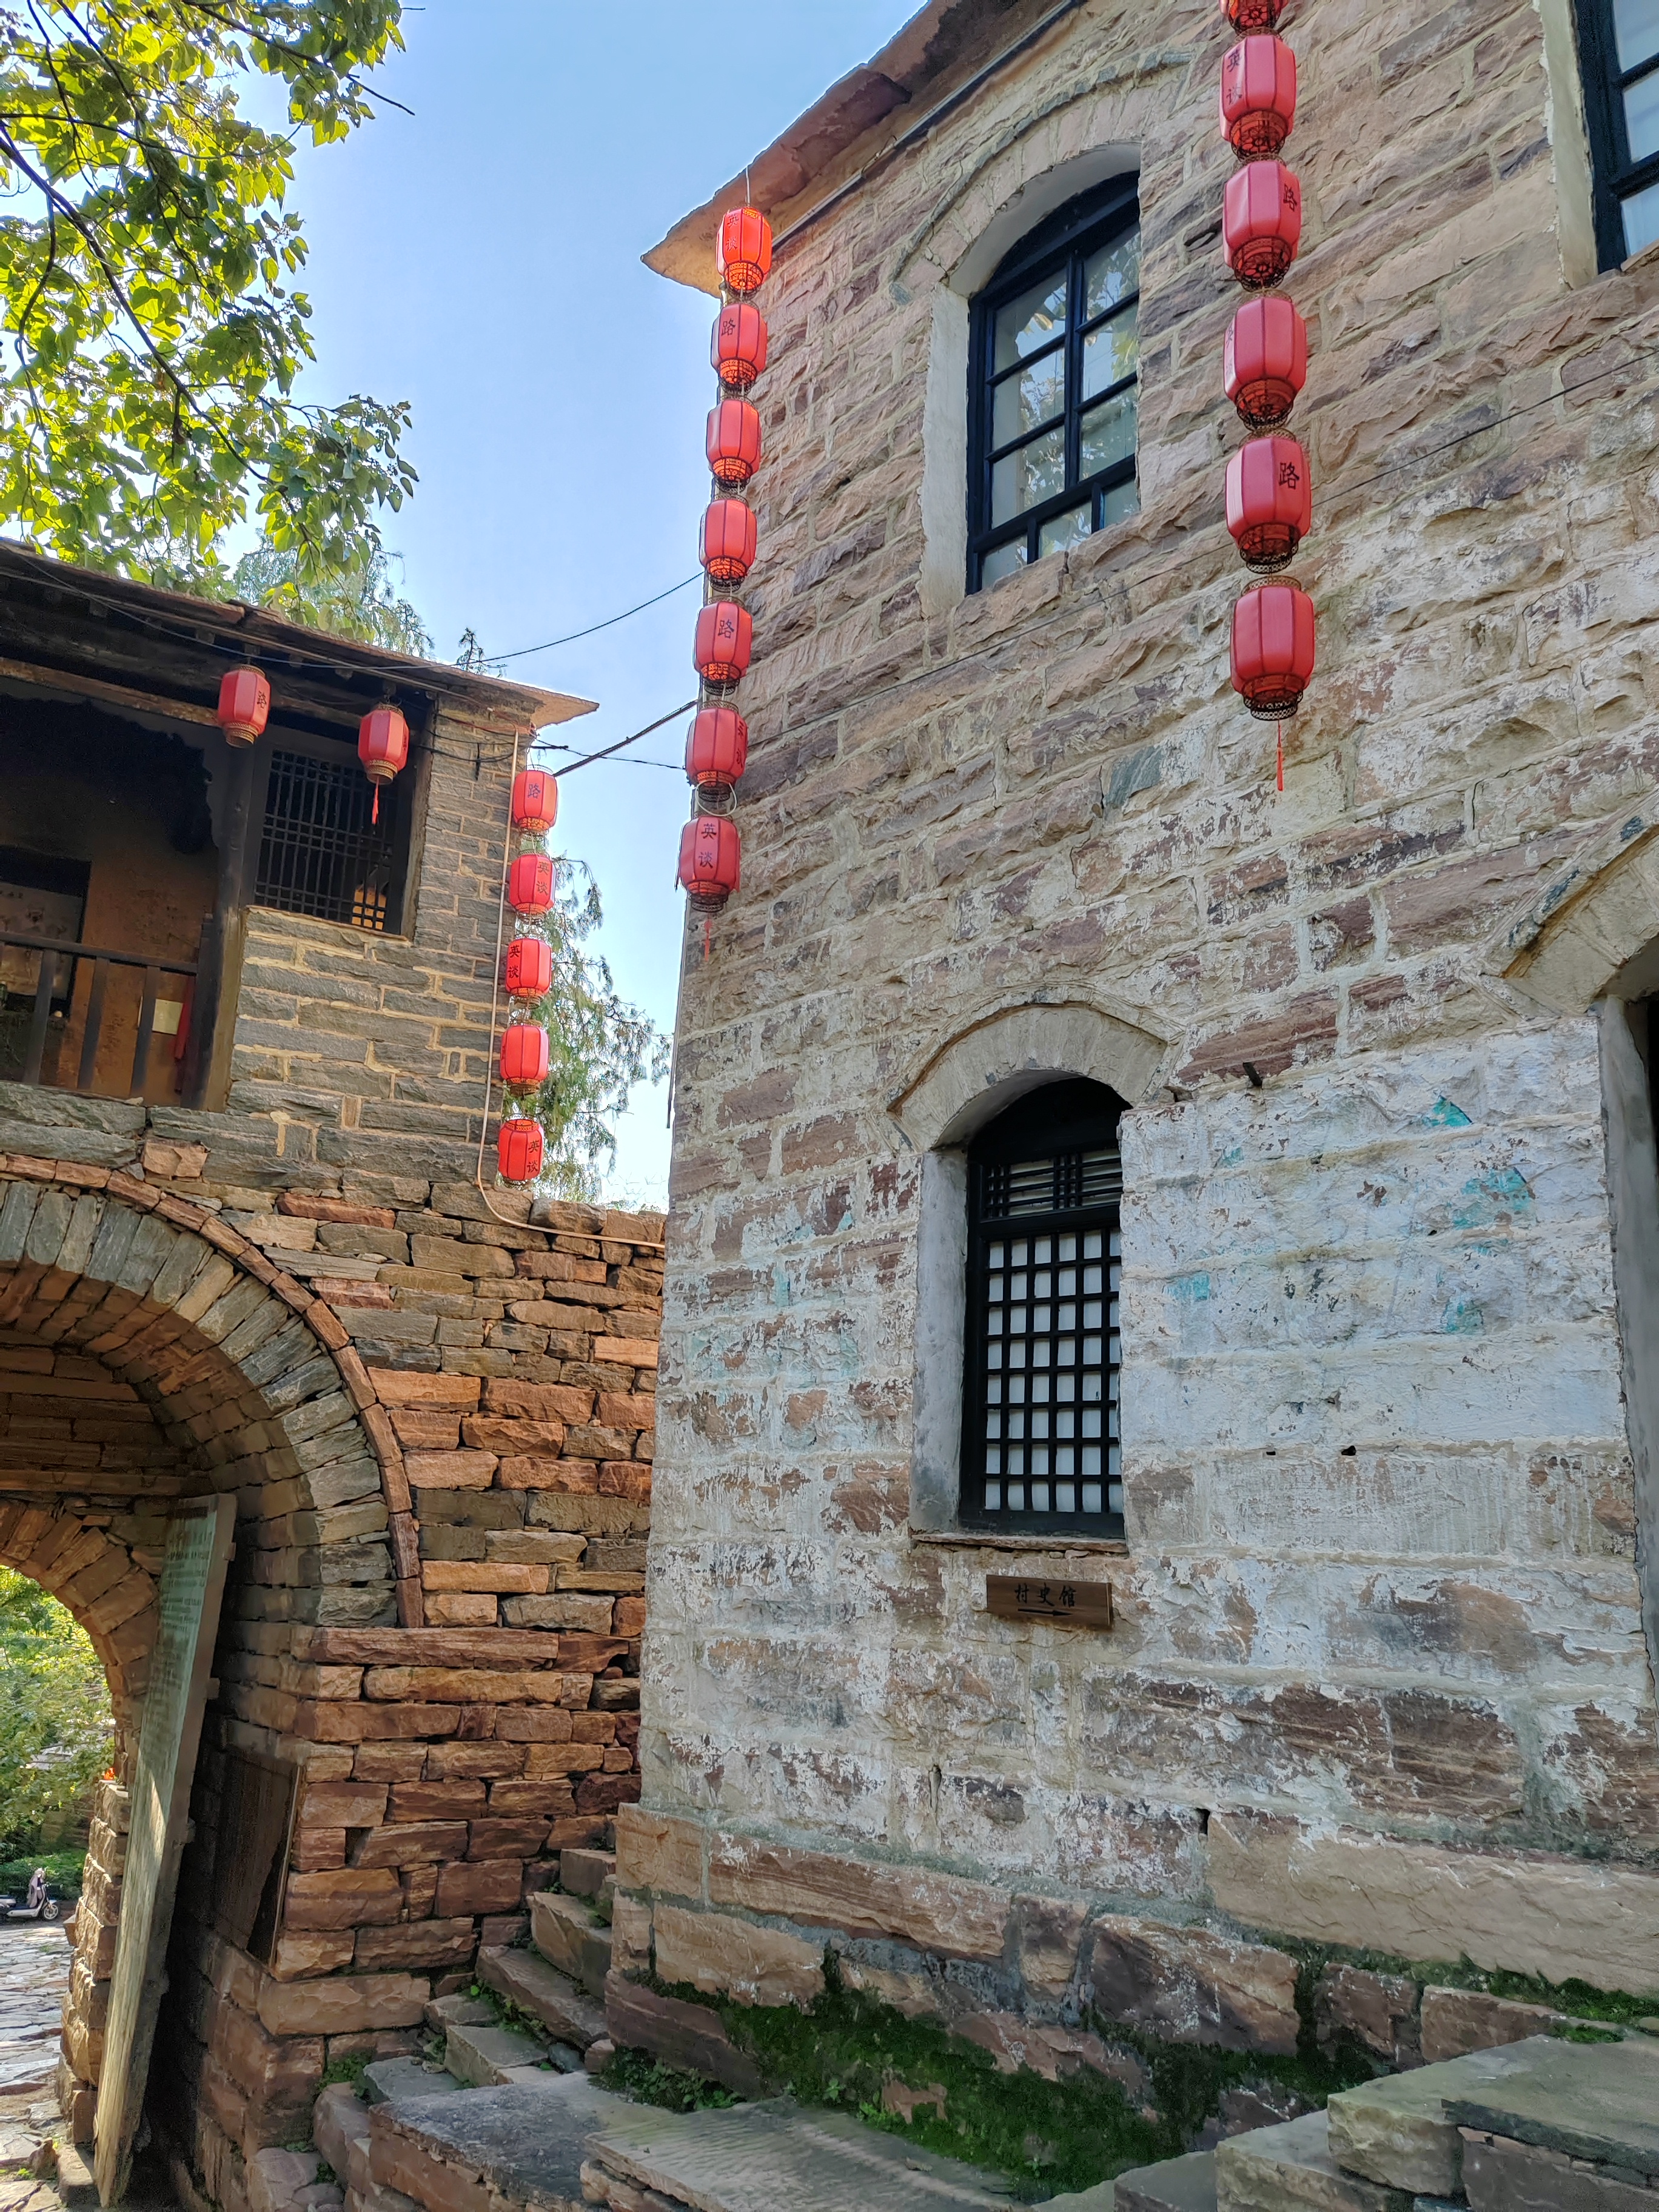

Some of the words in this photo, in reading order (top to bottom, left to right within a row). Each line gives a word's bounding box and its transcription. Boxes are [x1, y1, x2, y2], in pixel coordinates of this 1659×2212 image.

[725, 213, 739, 251] 英谈
[721, 318, 736, 335] 路
[1279, 461, 1299, 489] 路
[718, 619, 734, 638] 路
[528, 783, 540, 799] 路
[698, 823, 717, 868] 英谈
[536, 861, 550, 896] 英谈
[508, 944, 520, 979] 英谈
[526, 1139, 540, 1173] 英谈
[1014, 1582, 1077, 1608] 村史馆
